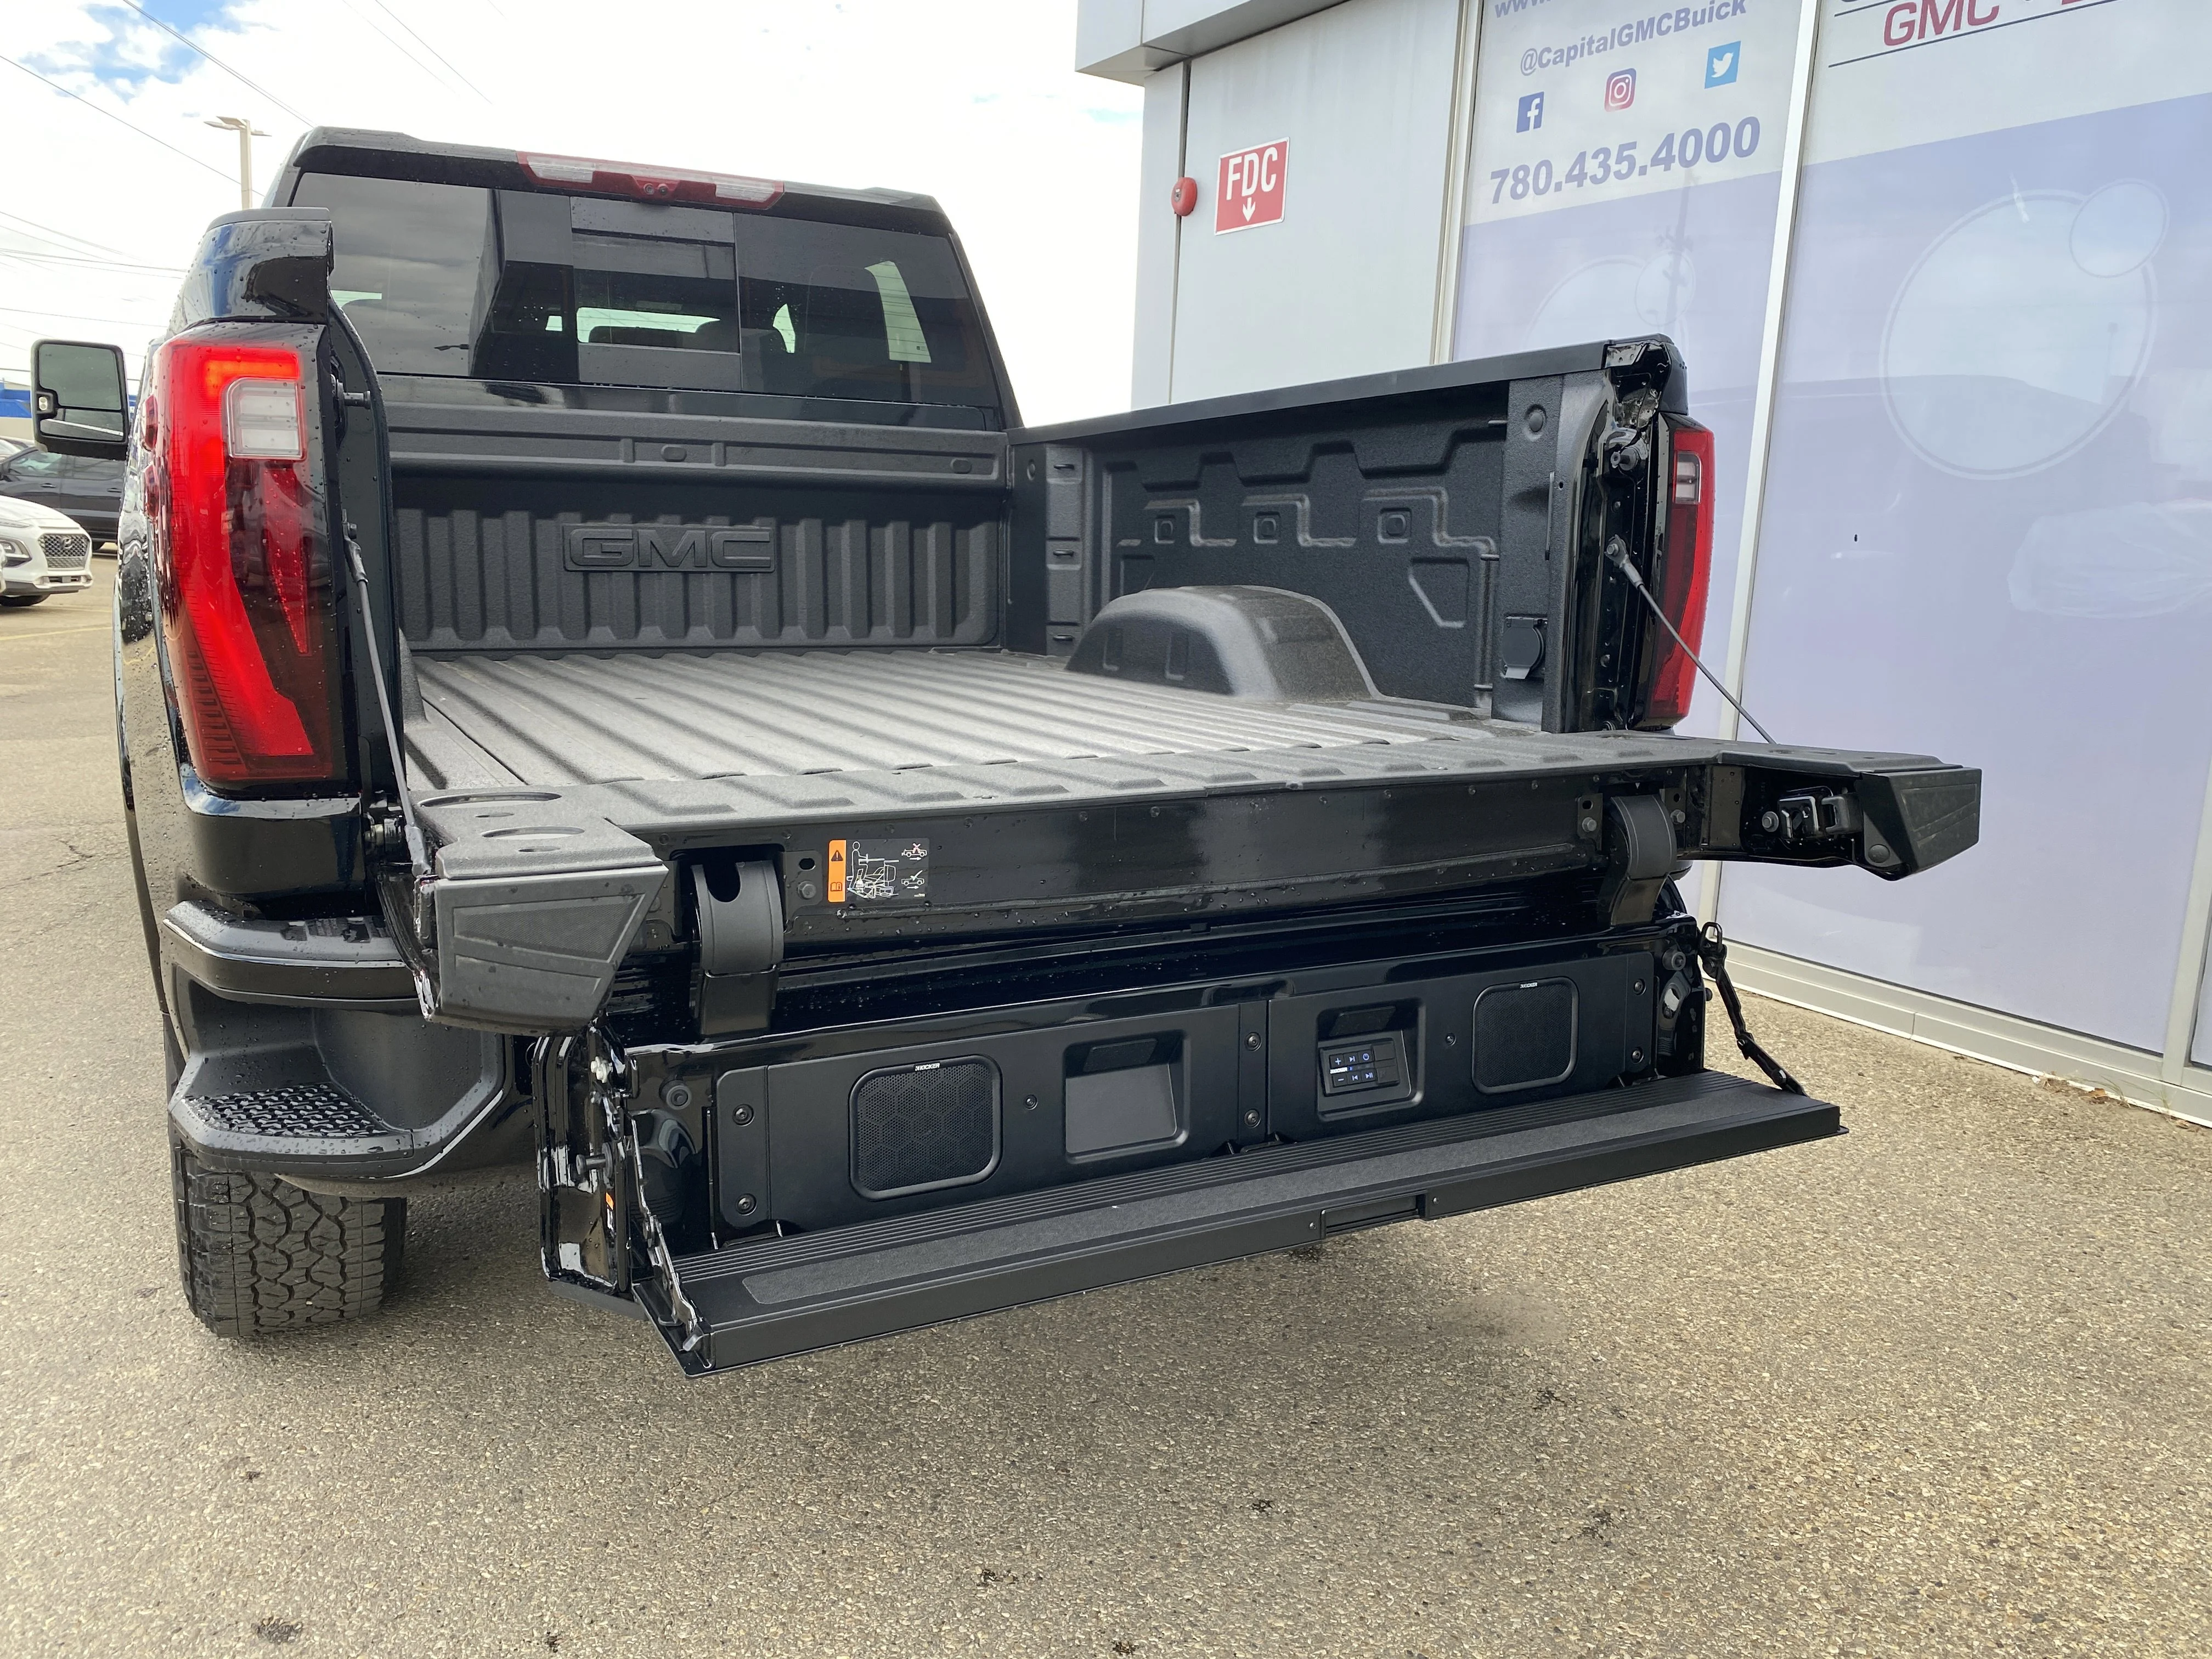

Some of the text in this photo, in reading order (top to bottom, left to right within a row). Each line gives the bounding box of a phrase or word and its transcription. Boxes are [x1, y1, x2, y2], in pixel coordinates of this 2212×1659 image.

[1520, 0, 1747, 76] @CapitalGMCBuick
[1883, 0, 2000, 46] GMC
[1226, 146, 1278, 200] FDC
[1490, 116, 1760, 204] 780.435.4000
[569, 528, 771, 568] GMC
